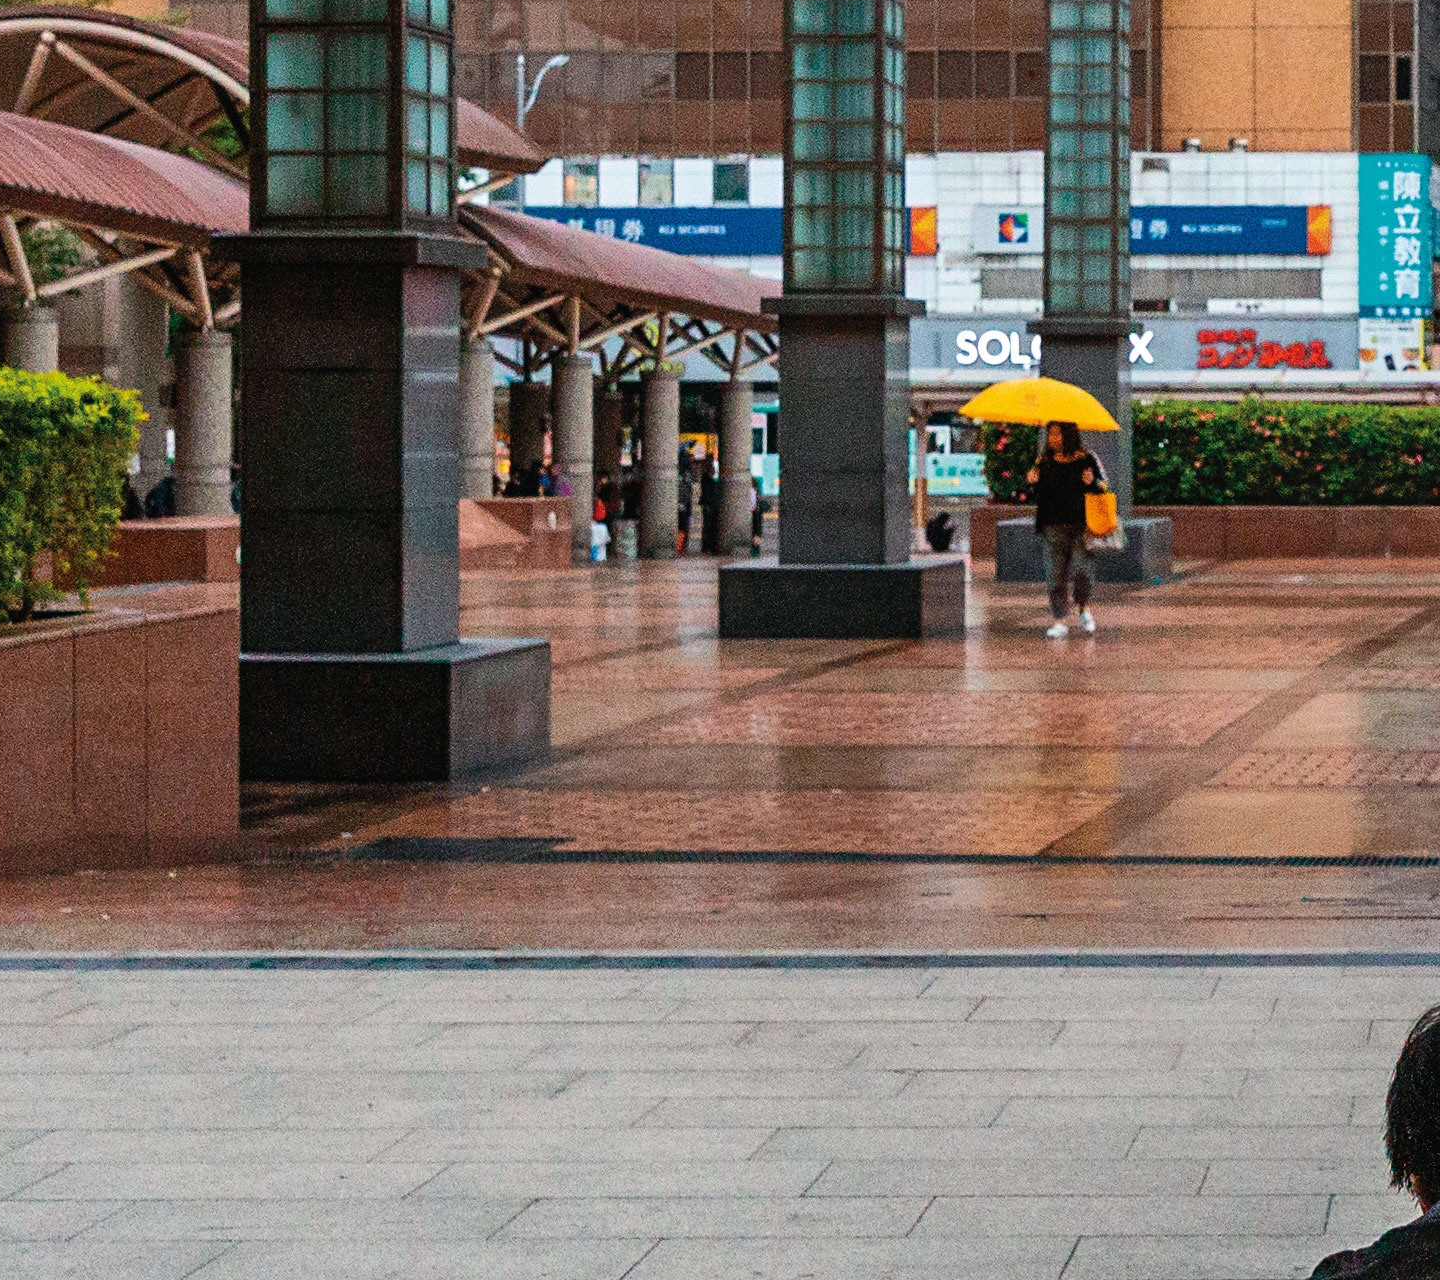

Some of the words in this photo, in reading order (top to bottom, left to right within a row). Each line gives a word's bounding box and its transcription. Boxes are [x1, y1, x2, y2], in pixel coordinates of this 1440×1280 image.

[1392, 171, 1421, 299] 陳立教育
[956, 329, 1155, 367] SOLX
